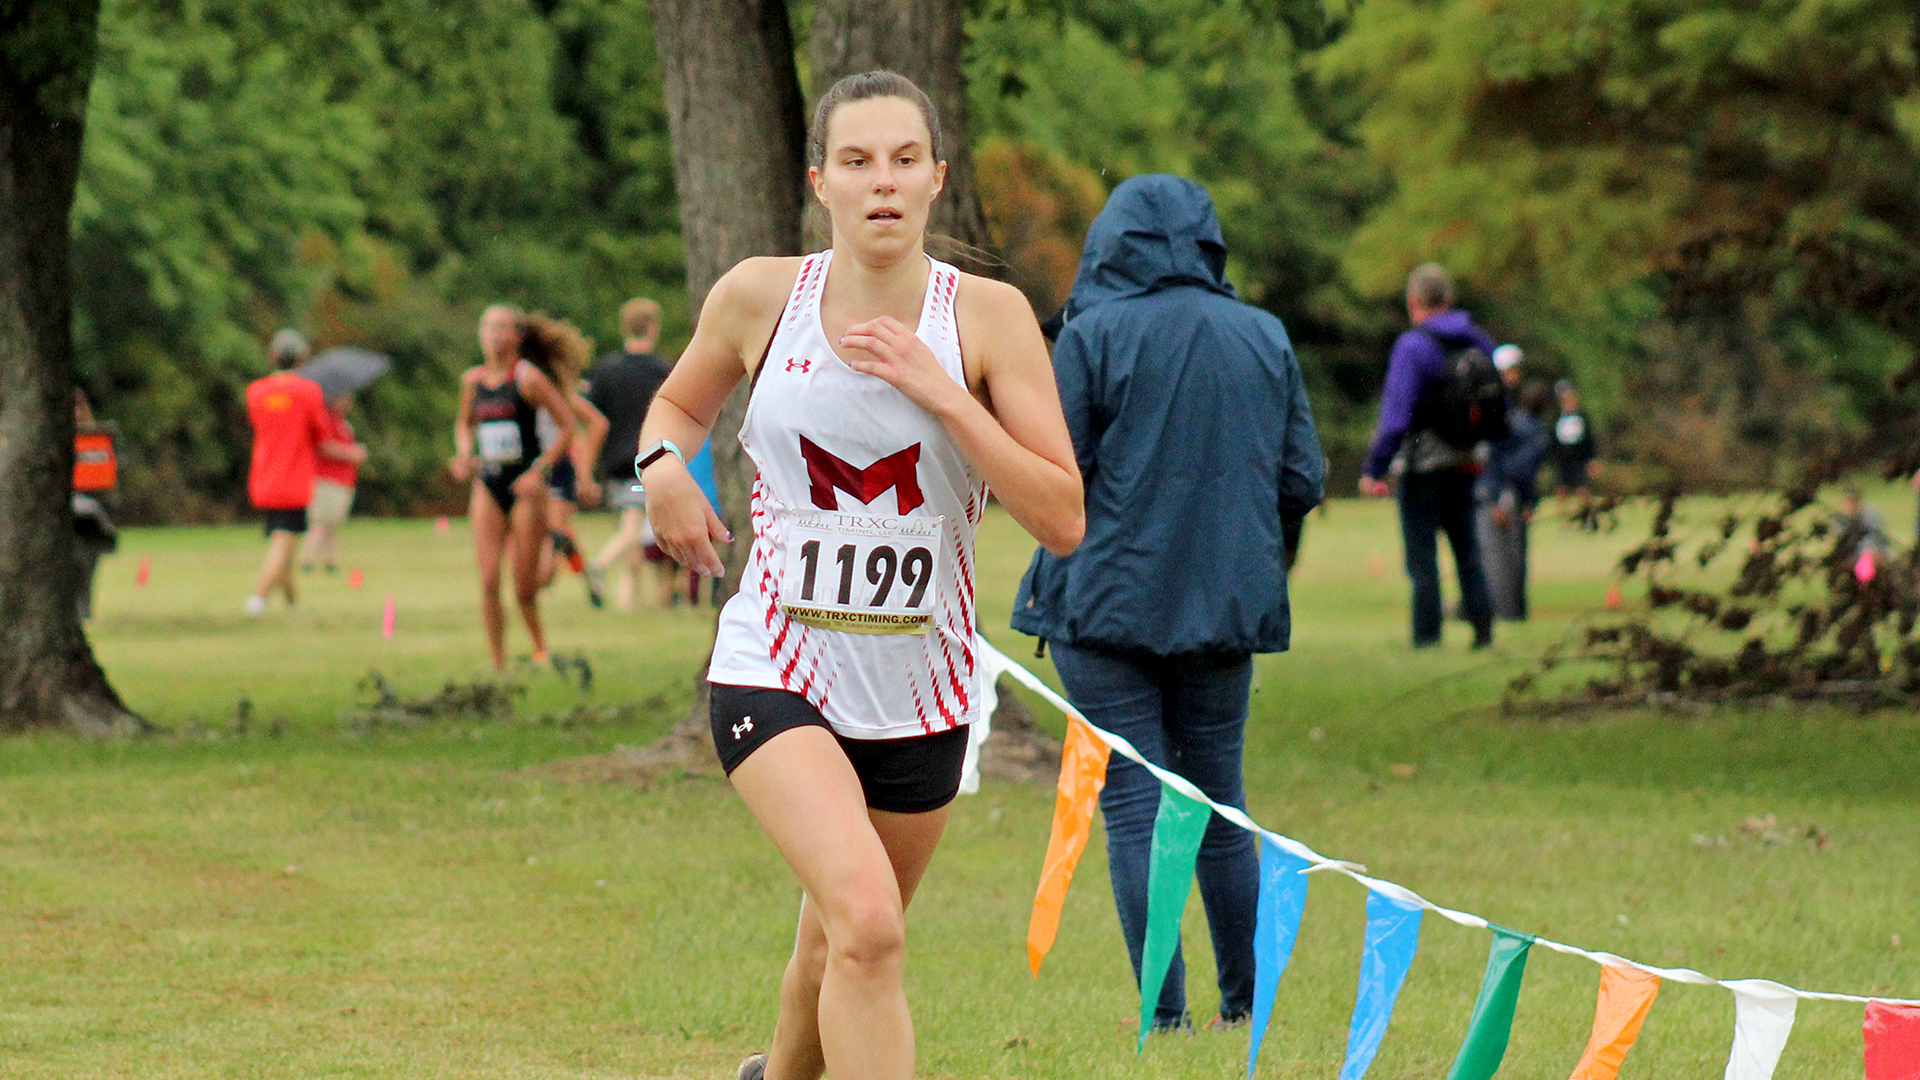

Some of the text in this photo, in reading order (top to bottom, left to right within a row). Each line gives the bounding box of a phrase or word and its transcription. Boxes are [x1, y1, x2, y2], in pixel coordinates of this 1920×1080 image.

[799, 433, 925, 516] M
[833, 514, 898, 530] TRXC
[800, 539, 933, 608] 1199
[787, 606, 928, 624] WWW.TRXCTIMING.COM
